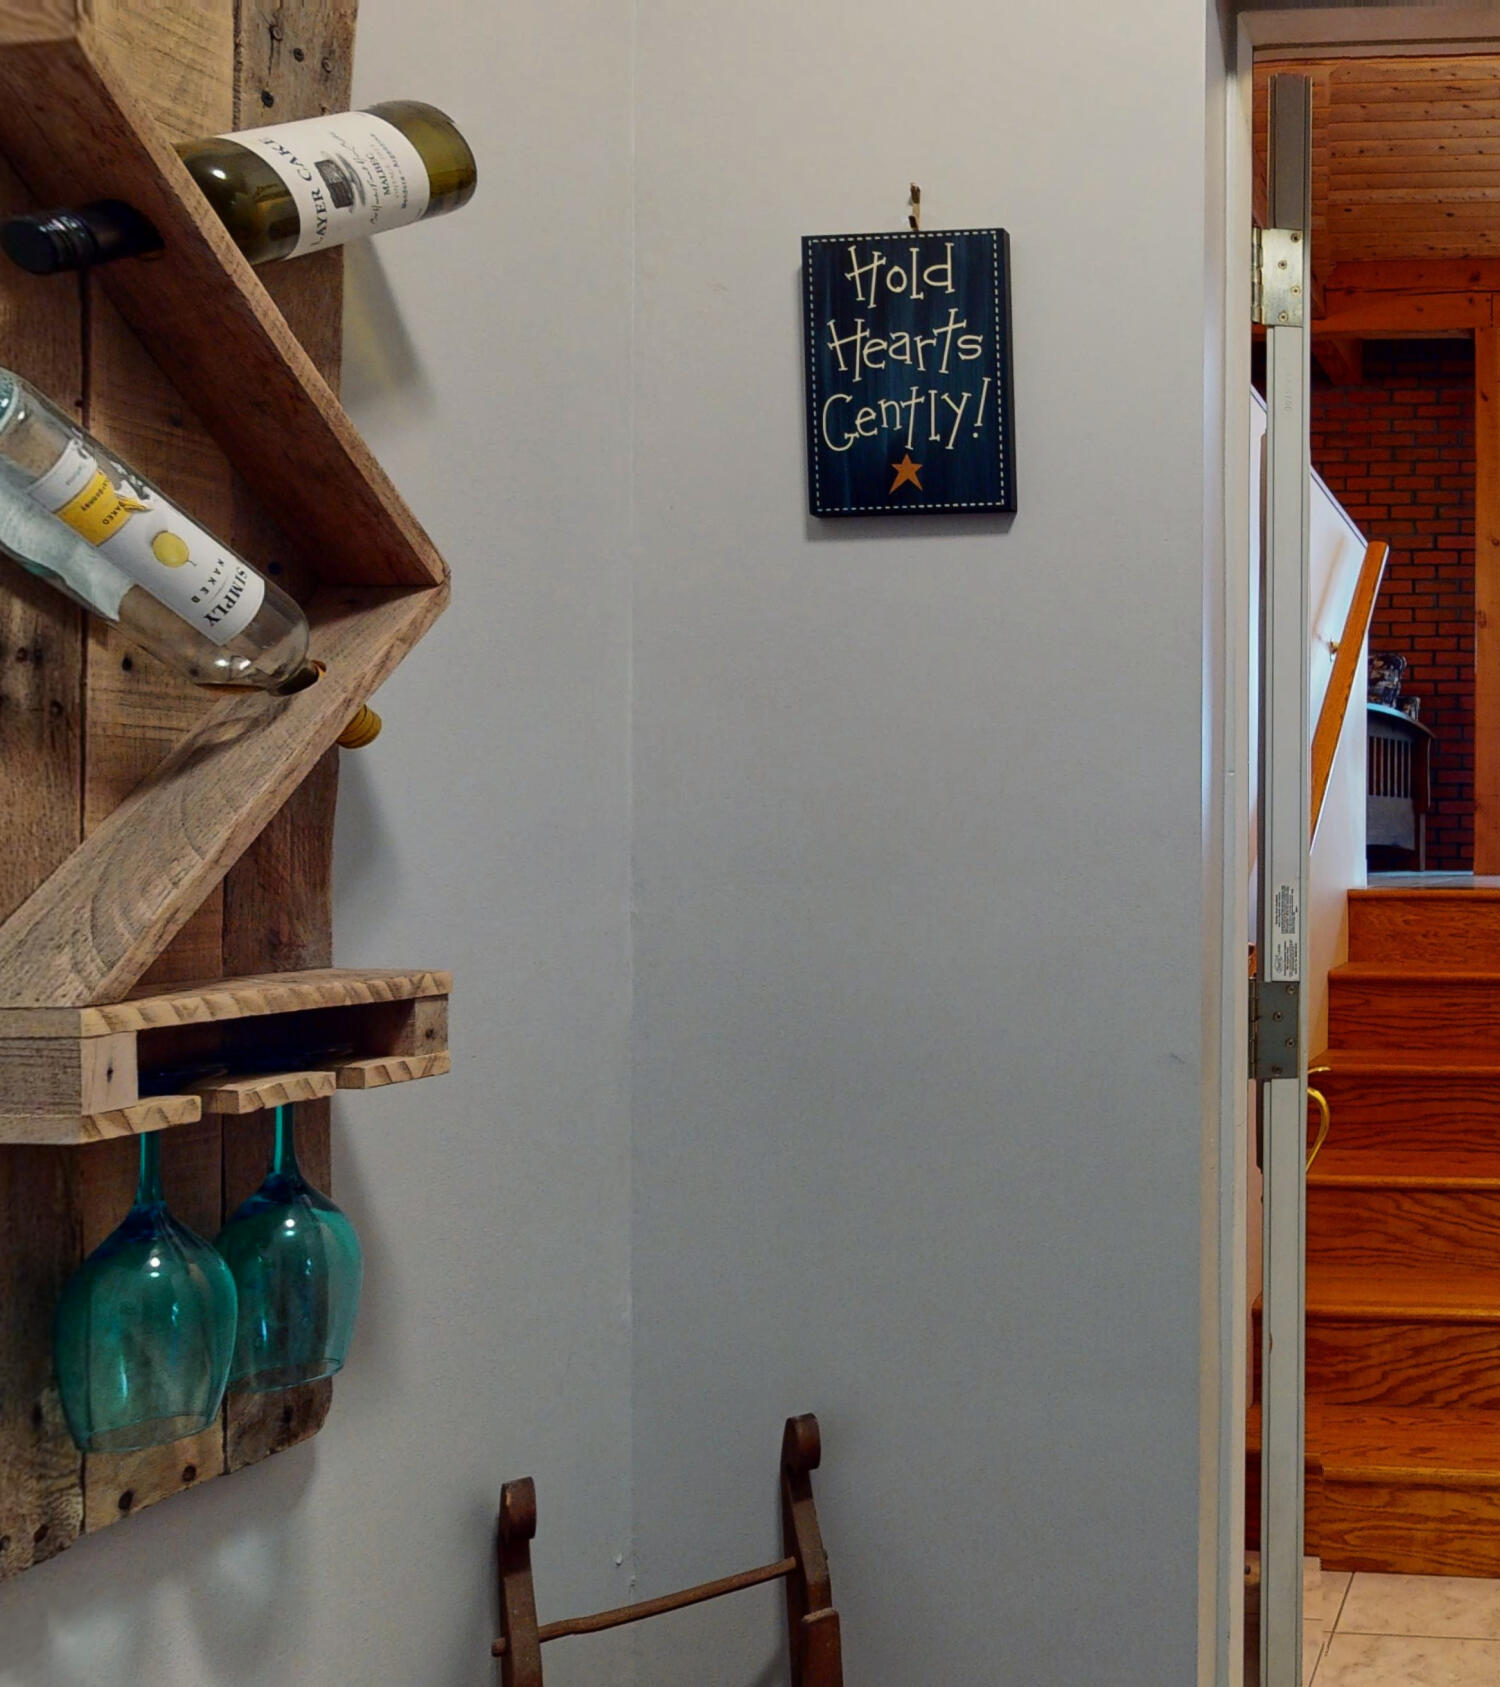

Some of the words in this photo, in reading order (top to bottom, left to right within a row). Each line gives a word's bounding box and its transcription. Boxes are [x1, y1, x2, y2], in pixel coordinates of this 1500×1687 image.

[258, 136, 313, 182] CAKE
[310, 187, 328, 247] LAYER
[844, 242, 956, 309] Hold
[827, 308, 984, 383] Hearts
[822, 377, 992, 452] Gently!
[190, 558, 225, 604] NAKED
[203, 566, 249, 627] SIMPLY
